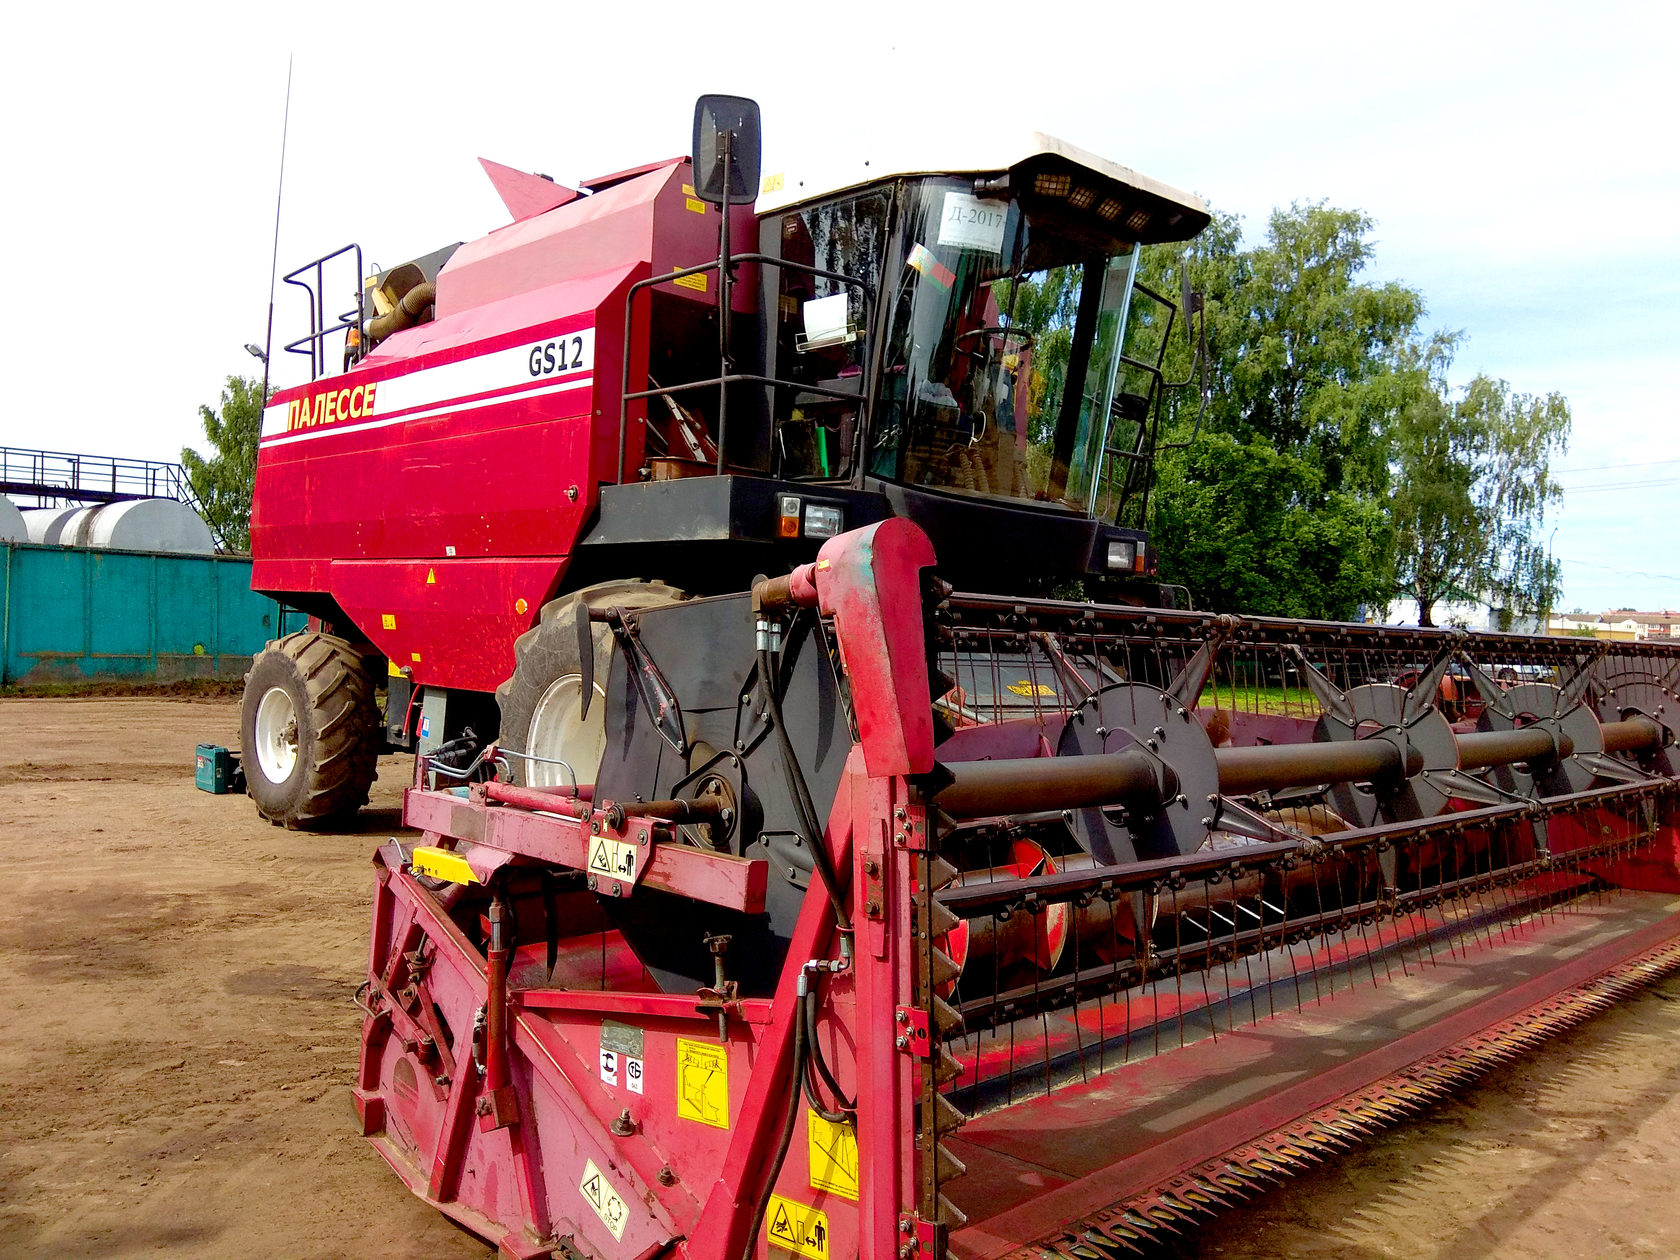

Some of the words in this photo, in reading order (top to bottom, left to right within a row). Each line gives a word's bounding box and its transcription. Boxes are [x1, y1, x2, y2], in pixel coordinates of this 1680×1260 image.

[529, 336, 583, 377] GS12
[286, 381, 378, 433] ПАЛЕССЕ
[603, 1213, 618, 1231] STOP
